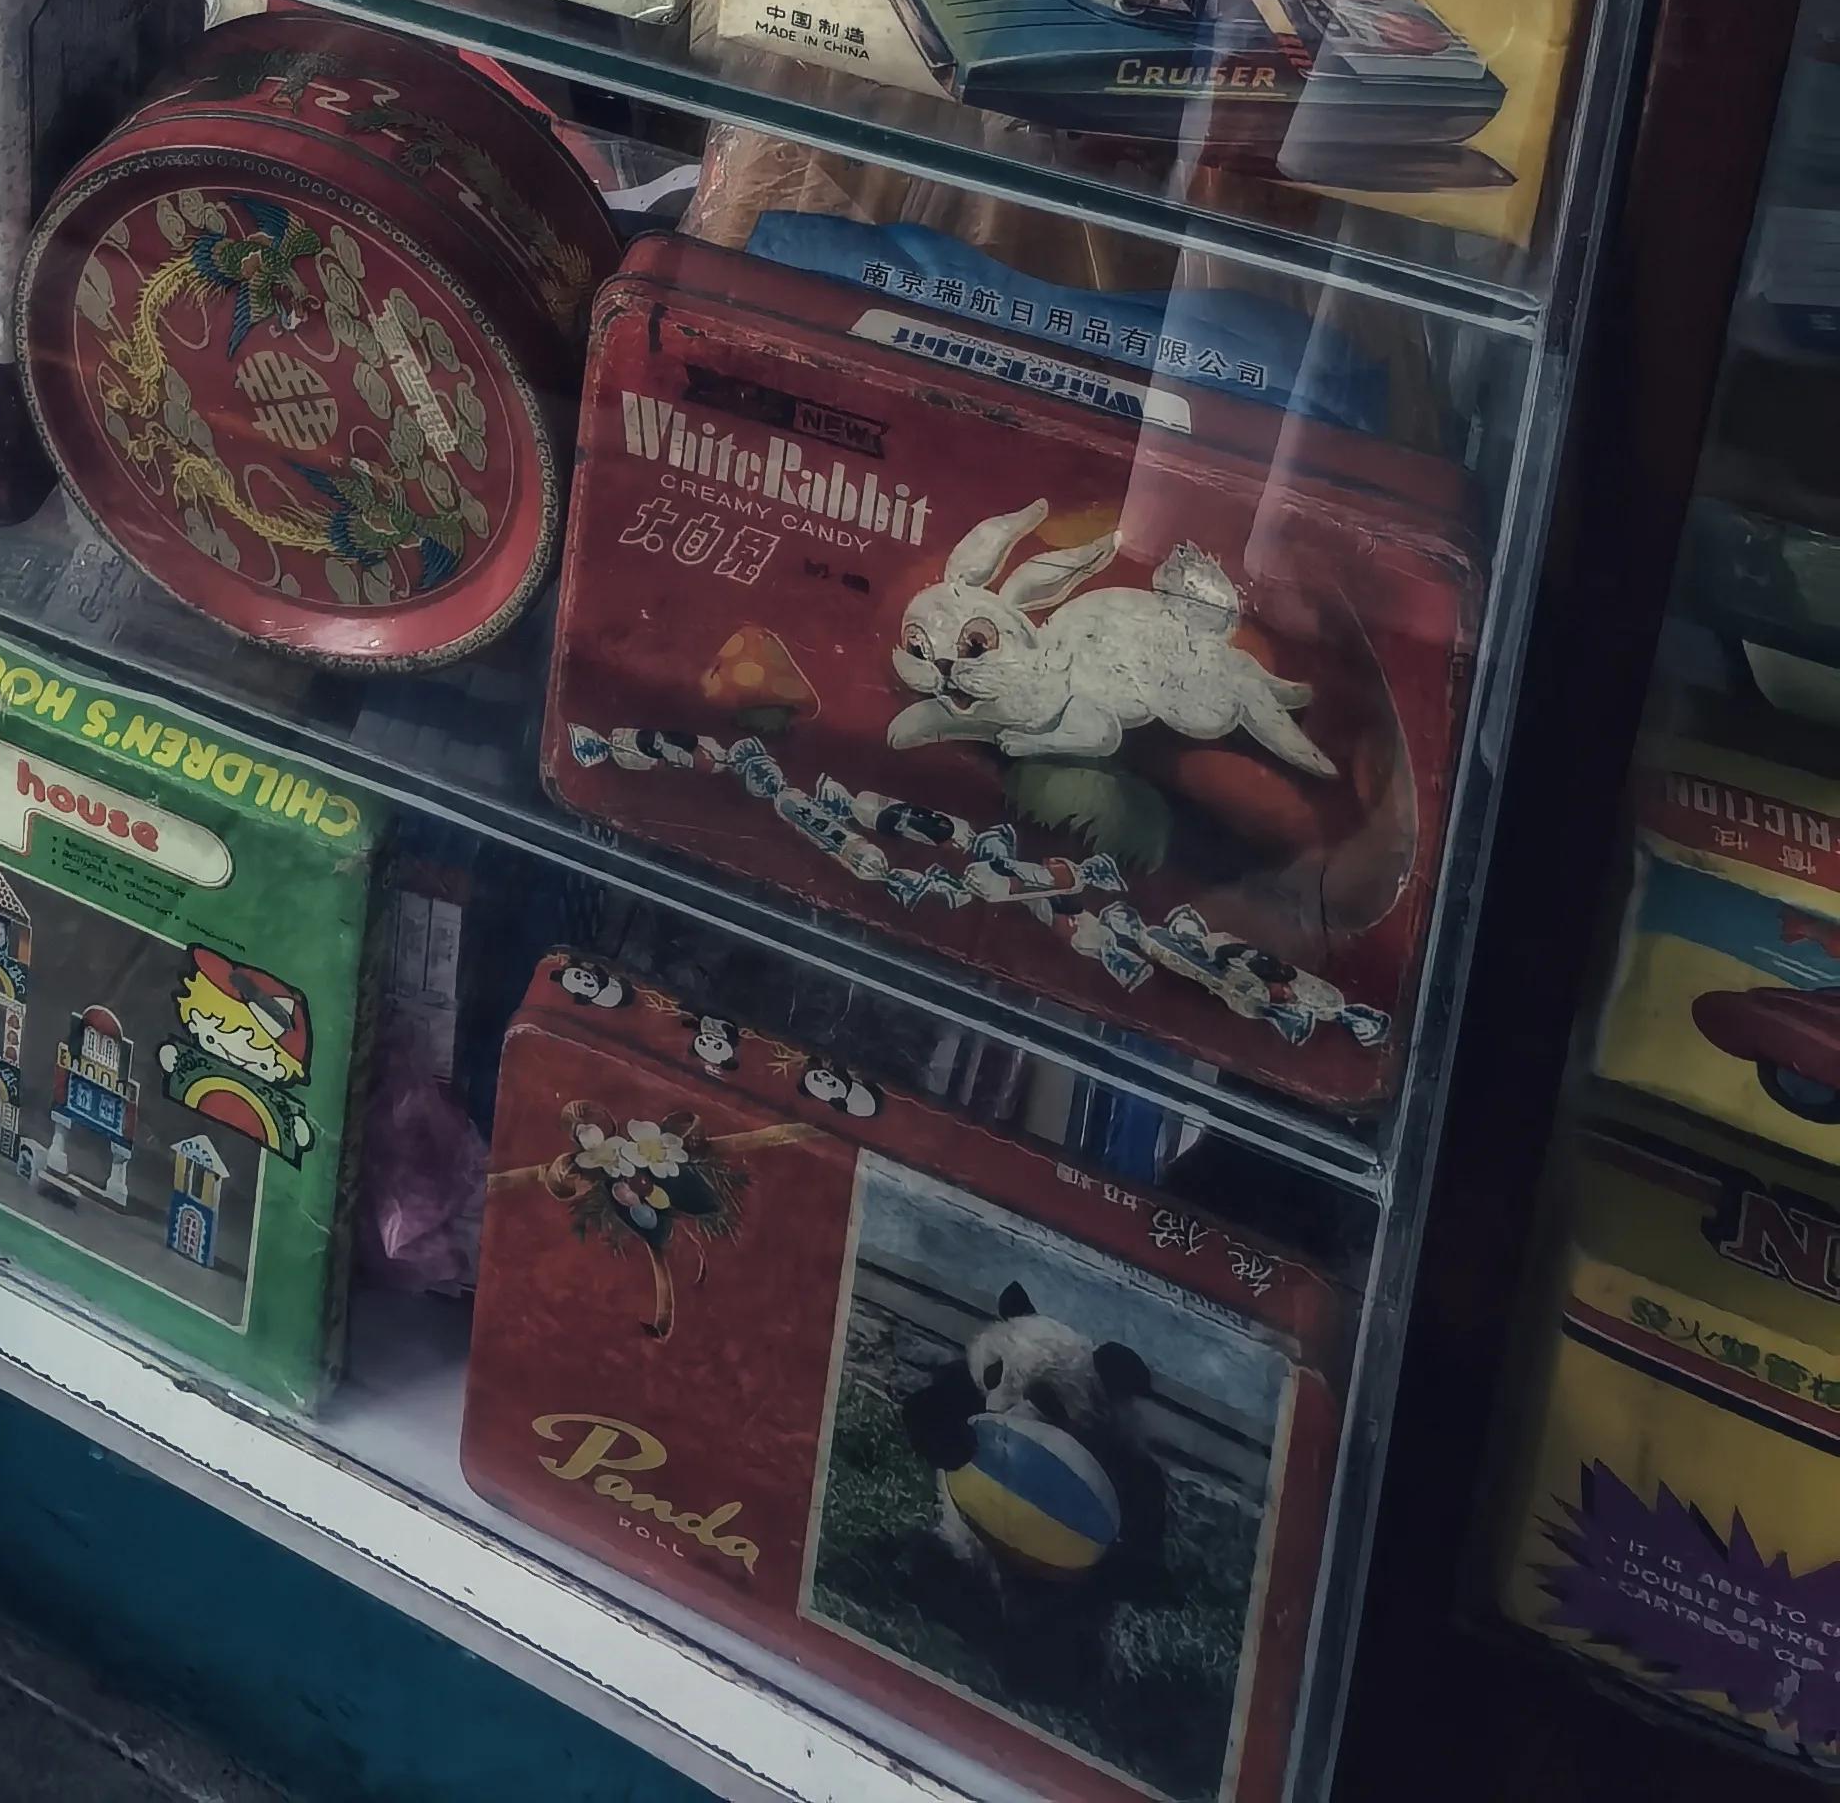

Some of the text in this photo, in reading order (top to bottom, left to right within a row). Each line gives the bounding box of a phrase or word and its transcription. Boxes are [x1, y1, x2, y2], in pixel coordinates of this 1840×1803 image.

[755, 19, 800, 43] MADE
[822, 35, 870, 62] CHINA
[764, 4, 868, 45] 中国制造
[1115, 57, 1277, 90] CRUISER
[861, 261, 1269, 389] 南京瑞航日用品有限公司
[659, 474, 872, 554] CREAMY CANDY
[16, 755, 161, 856] house
[82, 696, 361, 838] CHILDREN'S
[1665, 774, 1840, 854] RICTION
[531, 1412, 760, 1576] Panda
[1624, 1559, 1720, 1612] DOUBLE
[1774, 1600, 1807, 1625] TO
